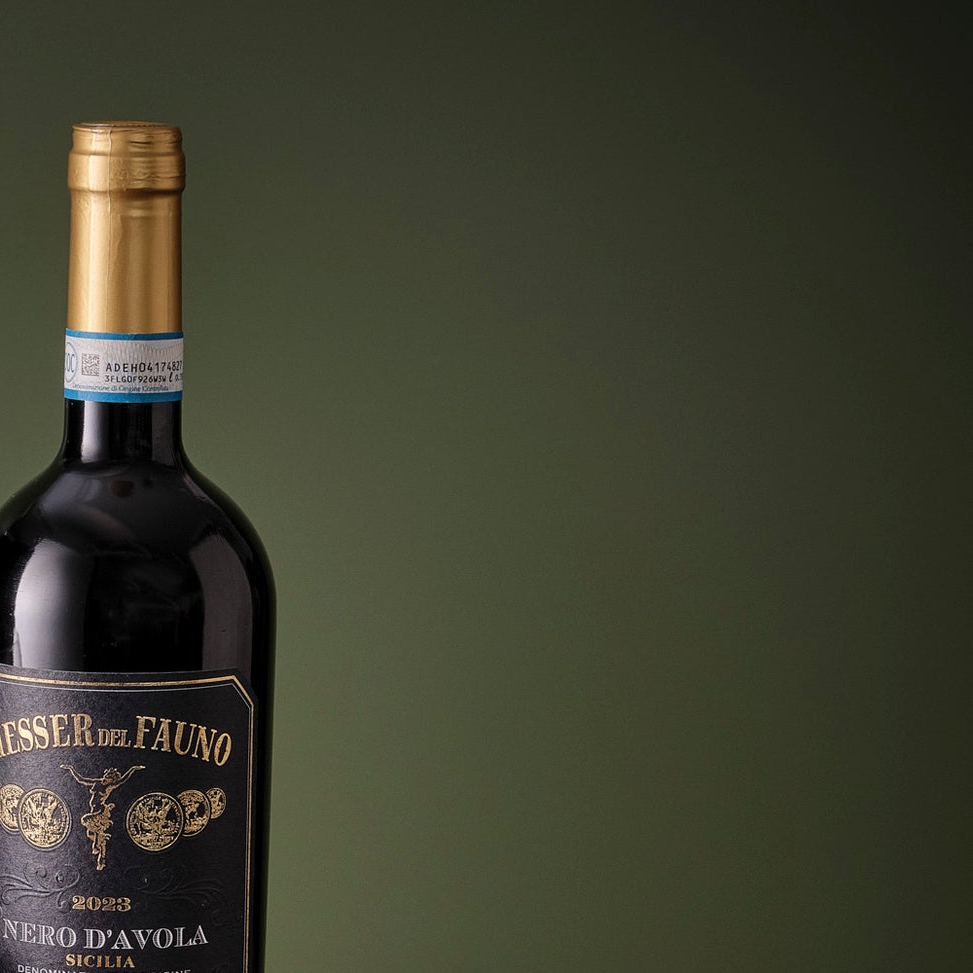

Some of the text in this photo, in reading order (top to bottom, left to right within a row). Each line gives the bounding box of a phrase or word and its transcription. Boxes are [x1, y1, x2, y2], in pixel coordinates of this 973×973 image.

[97, 728, 132, 748] DEL
[135, 715, 232, 767] FAUNO
[71, 895, 132, 912] 2023
[2, 918, 209, 950] NERO D'AVOLA
[65, 954, 135, 968] SICILIA
